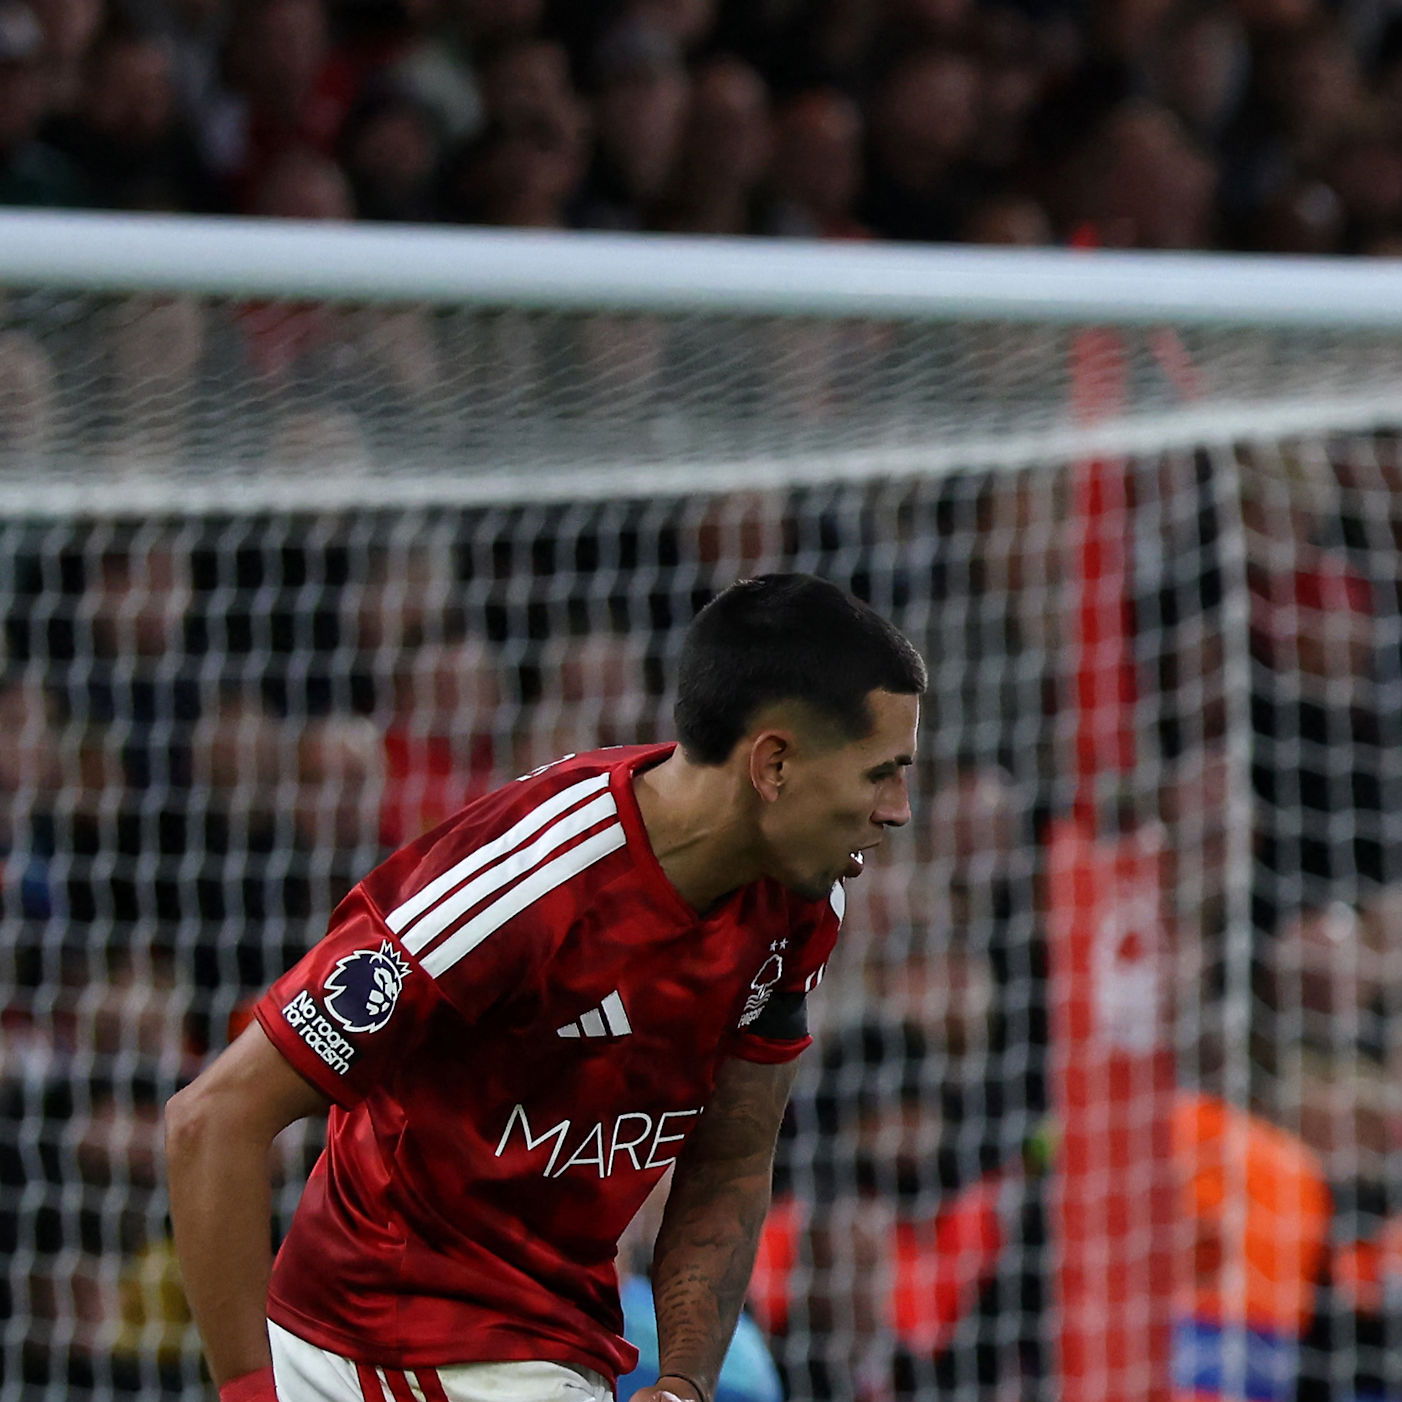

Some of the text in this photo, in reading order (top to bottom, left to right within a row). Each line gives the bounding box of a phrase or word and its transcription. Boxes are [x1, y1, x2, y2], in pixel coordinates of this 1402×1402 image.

[293, 989, 354, 1060] No room
[299, 1024, 350, 1075] racism
[495, 1103, 704, 1179] MARE
